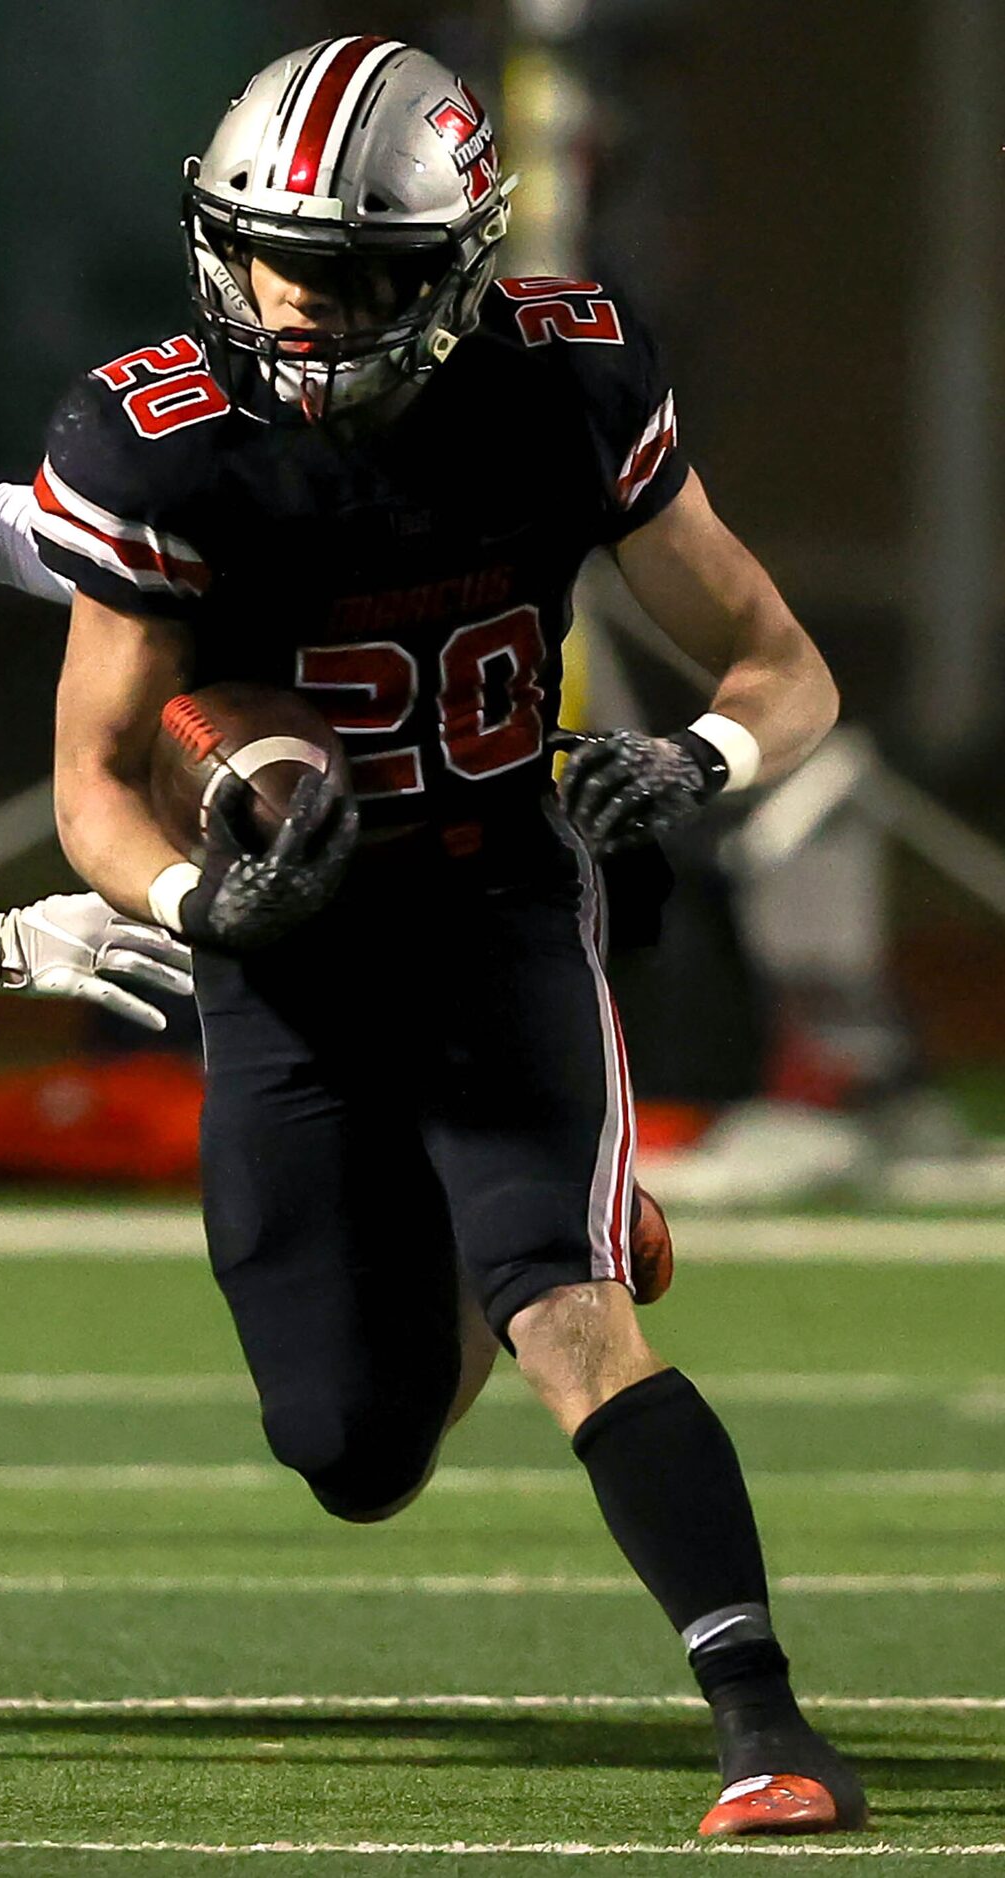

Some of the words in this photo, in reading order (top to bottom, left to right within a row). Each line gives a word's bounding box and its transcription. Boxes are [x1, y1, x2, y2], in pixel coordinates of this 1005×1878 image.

[213, 265, 248, 312] VICIS
[494, 273, 625, 347] 20
[91, 333, 232, 440] 20
[295, 603, 547, 800] 20
